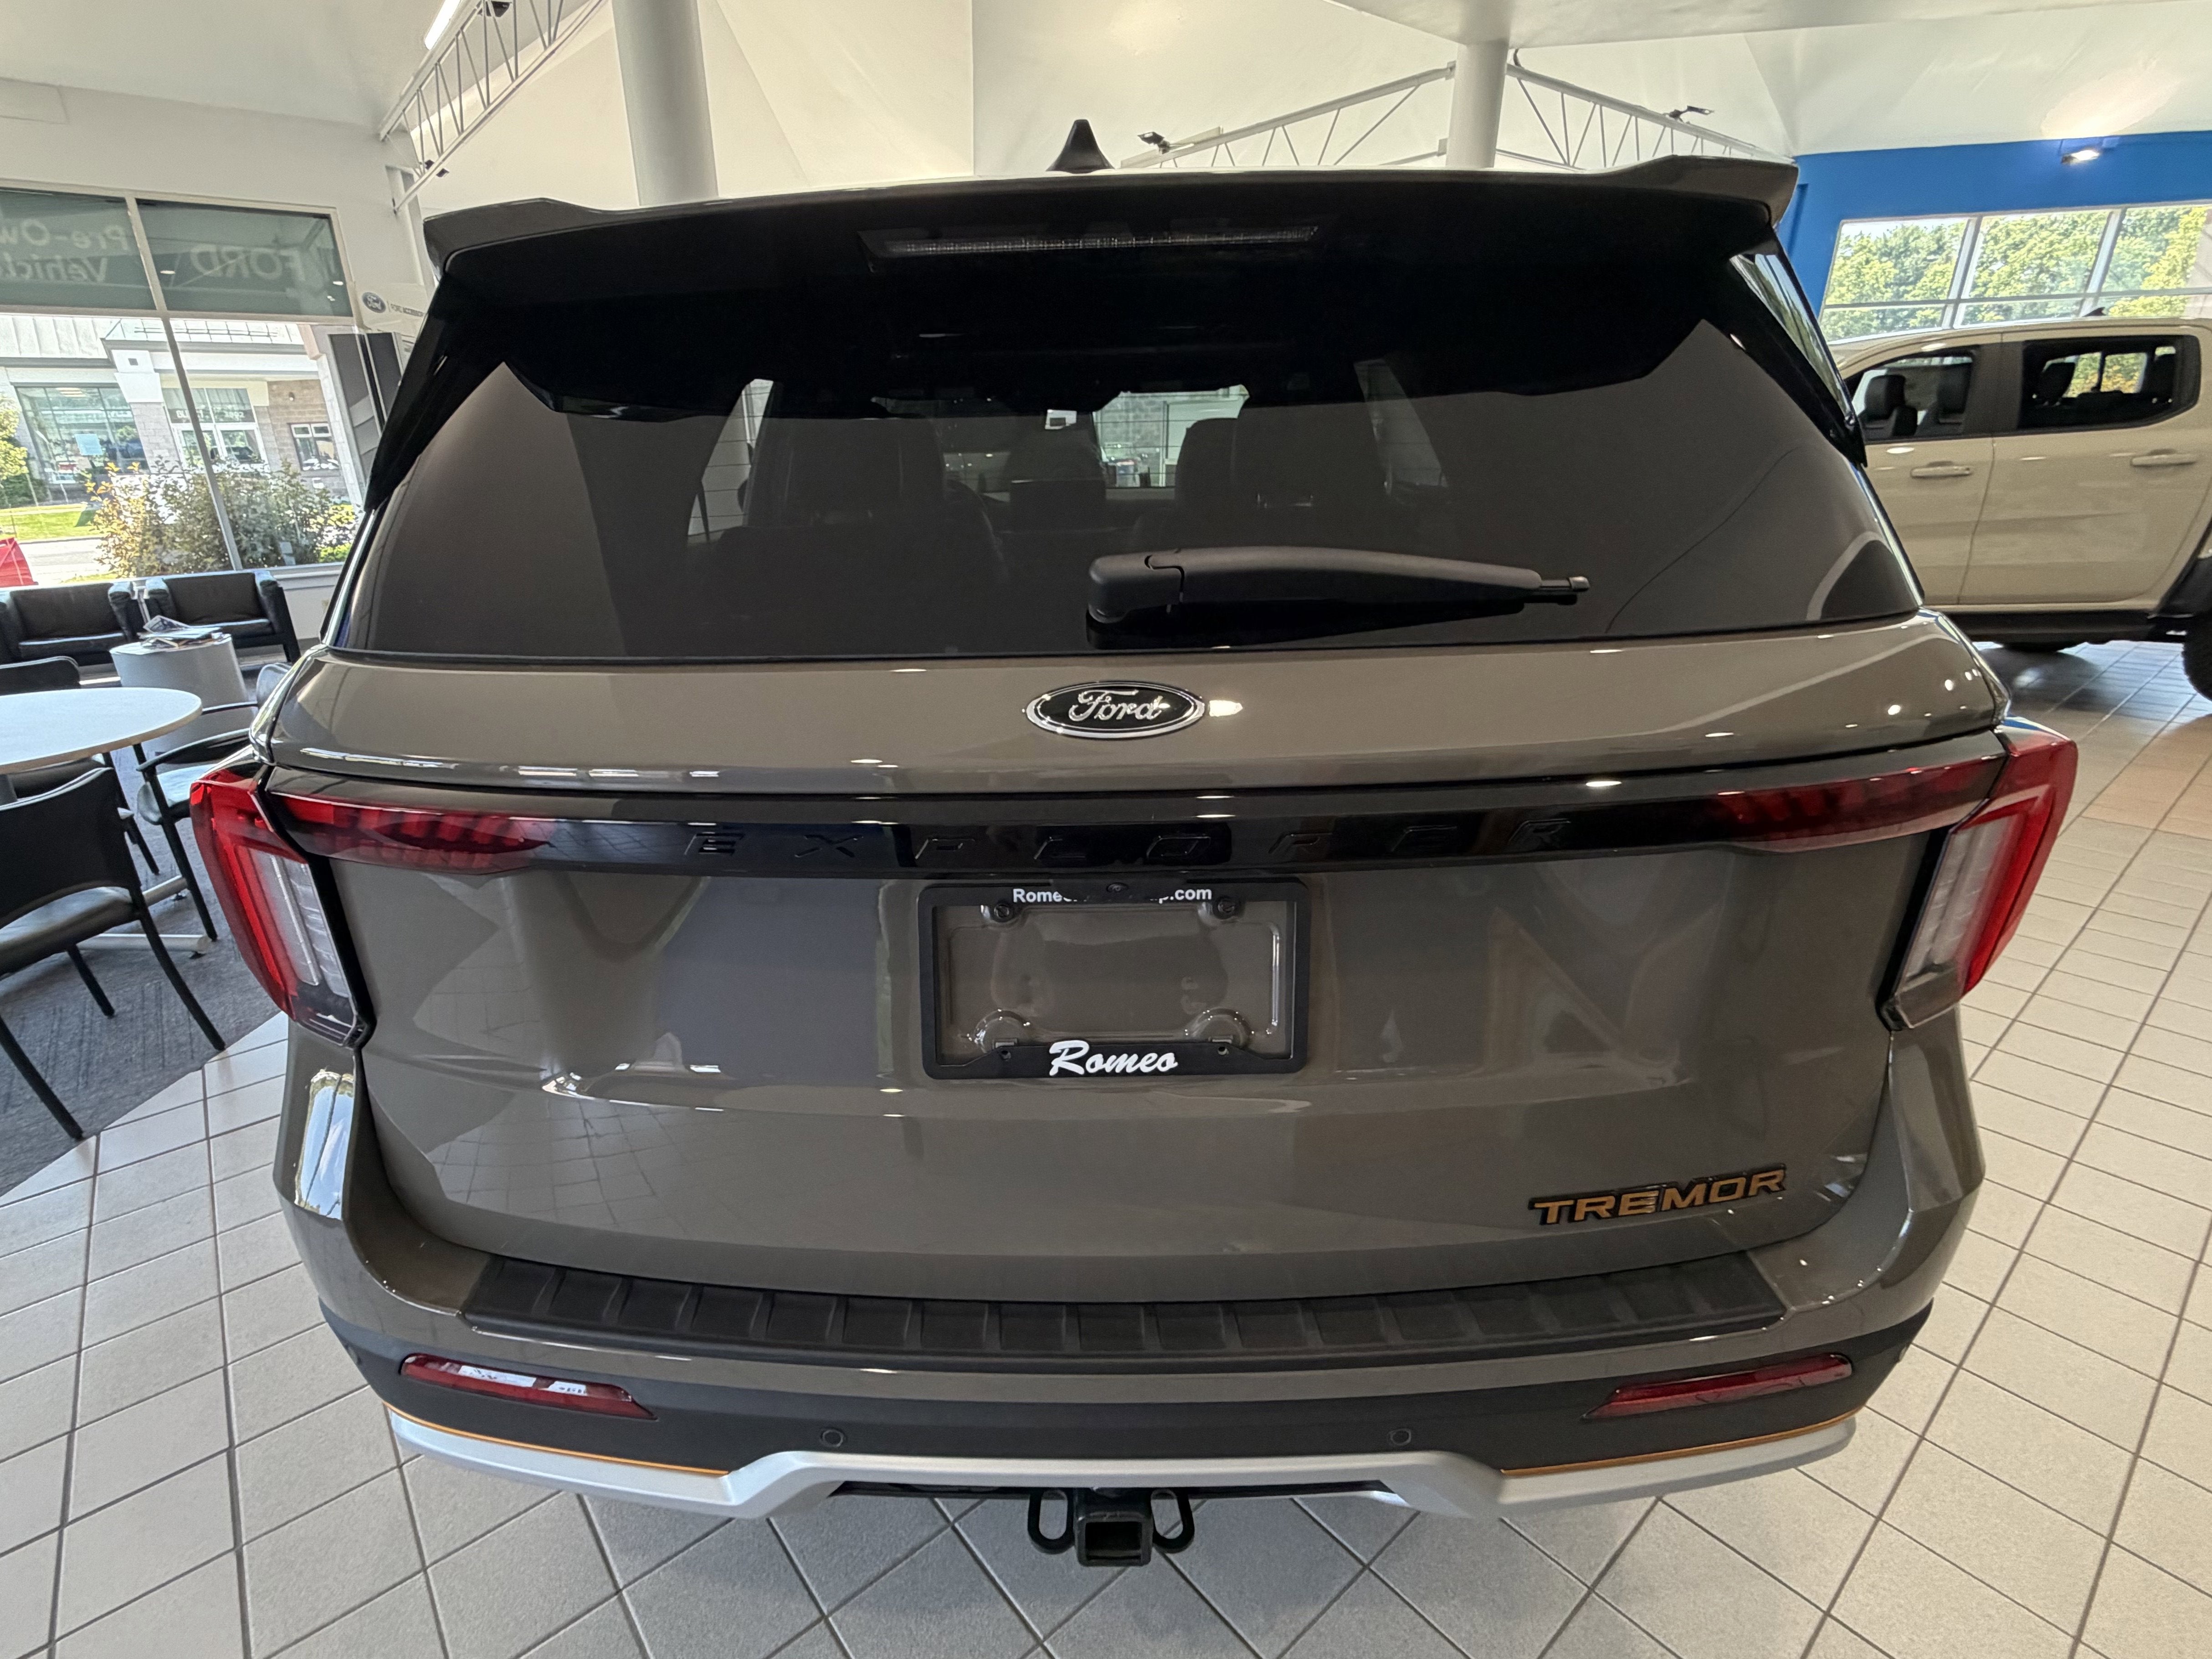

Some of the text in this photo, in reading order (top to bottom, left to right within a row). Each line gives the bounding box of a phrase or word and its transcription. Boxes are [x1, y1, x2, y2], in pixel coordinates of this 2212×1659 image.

[1068, 689, 1165, 722] Ford
[1049, 1039, 1179, 1076] Romeo
[1529, 1164, 1786, 1225] TREMOR
